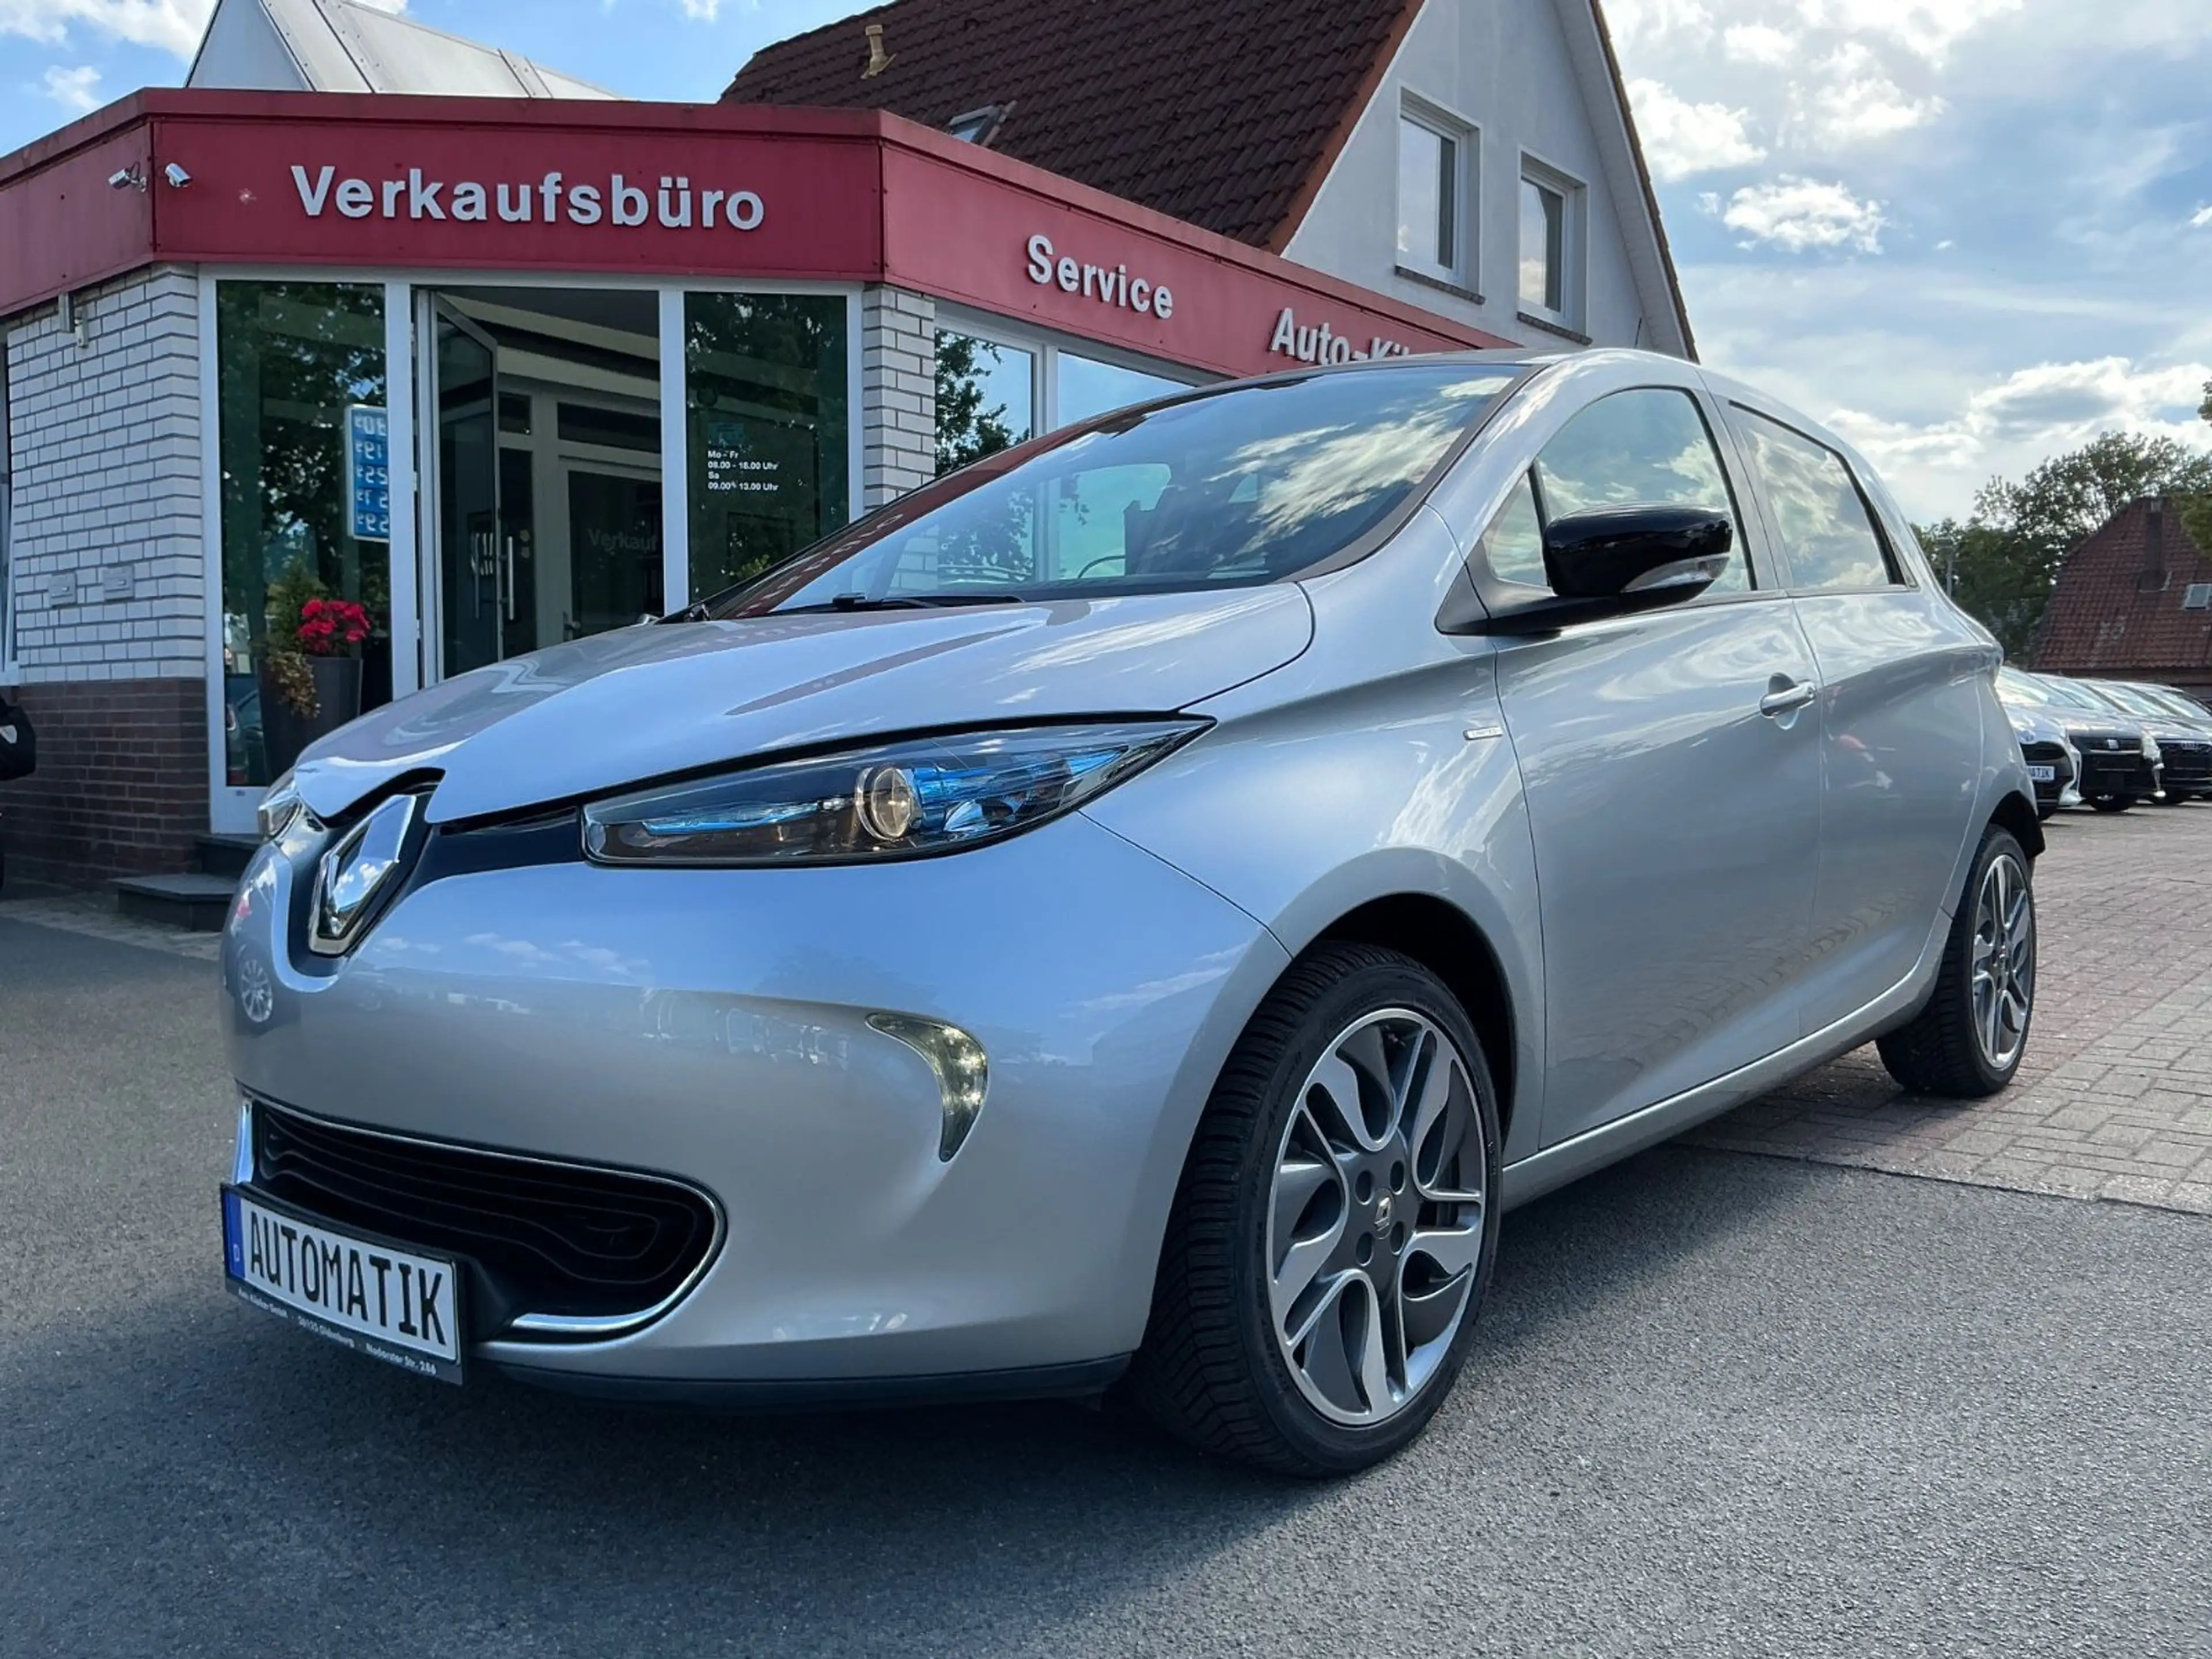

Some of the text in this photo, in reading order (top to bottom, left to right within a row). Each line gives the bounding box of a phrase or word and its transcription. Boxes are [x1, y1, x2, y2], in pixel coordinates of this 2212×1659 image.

[290, 165, 766, 231] Verkaufsbüro
[1026, 233, 1173, 320] Service
[1271, 306, 1410, 366] Auto-K
[707, 450, 721, 459] Mo
[729, 450, 739, 459] Fr
[762, 461, 779, 470] Uhr
[707, 471, 719, 480] Sa
[707, 481, 731, 490] 09.00
[762, 482, 779, 491] Uhr
[250, 1210, 447, 1346] AUTOMATIK
